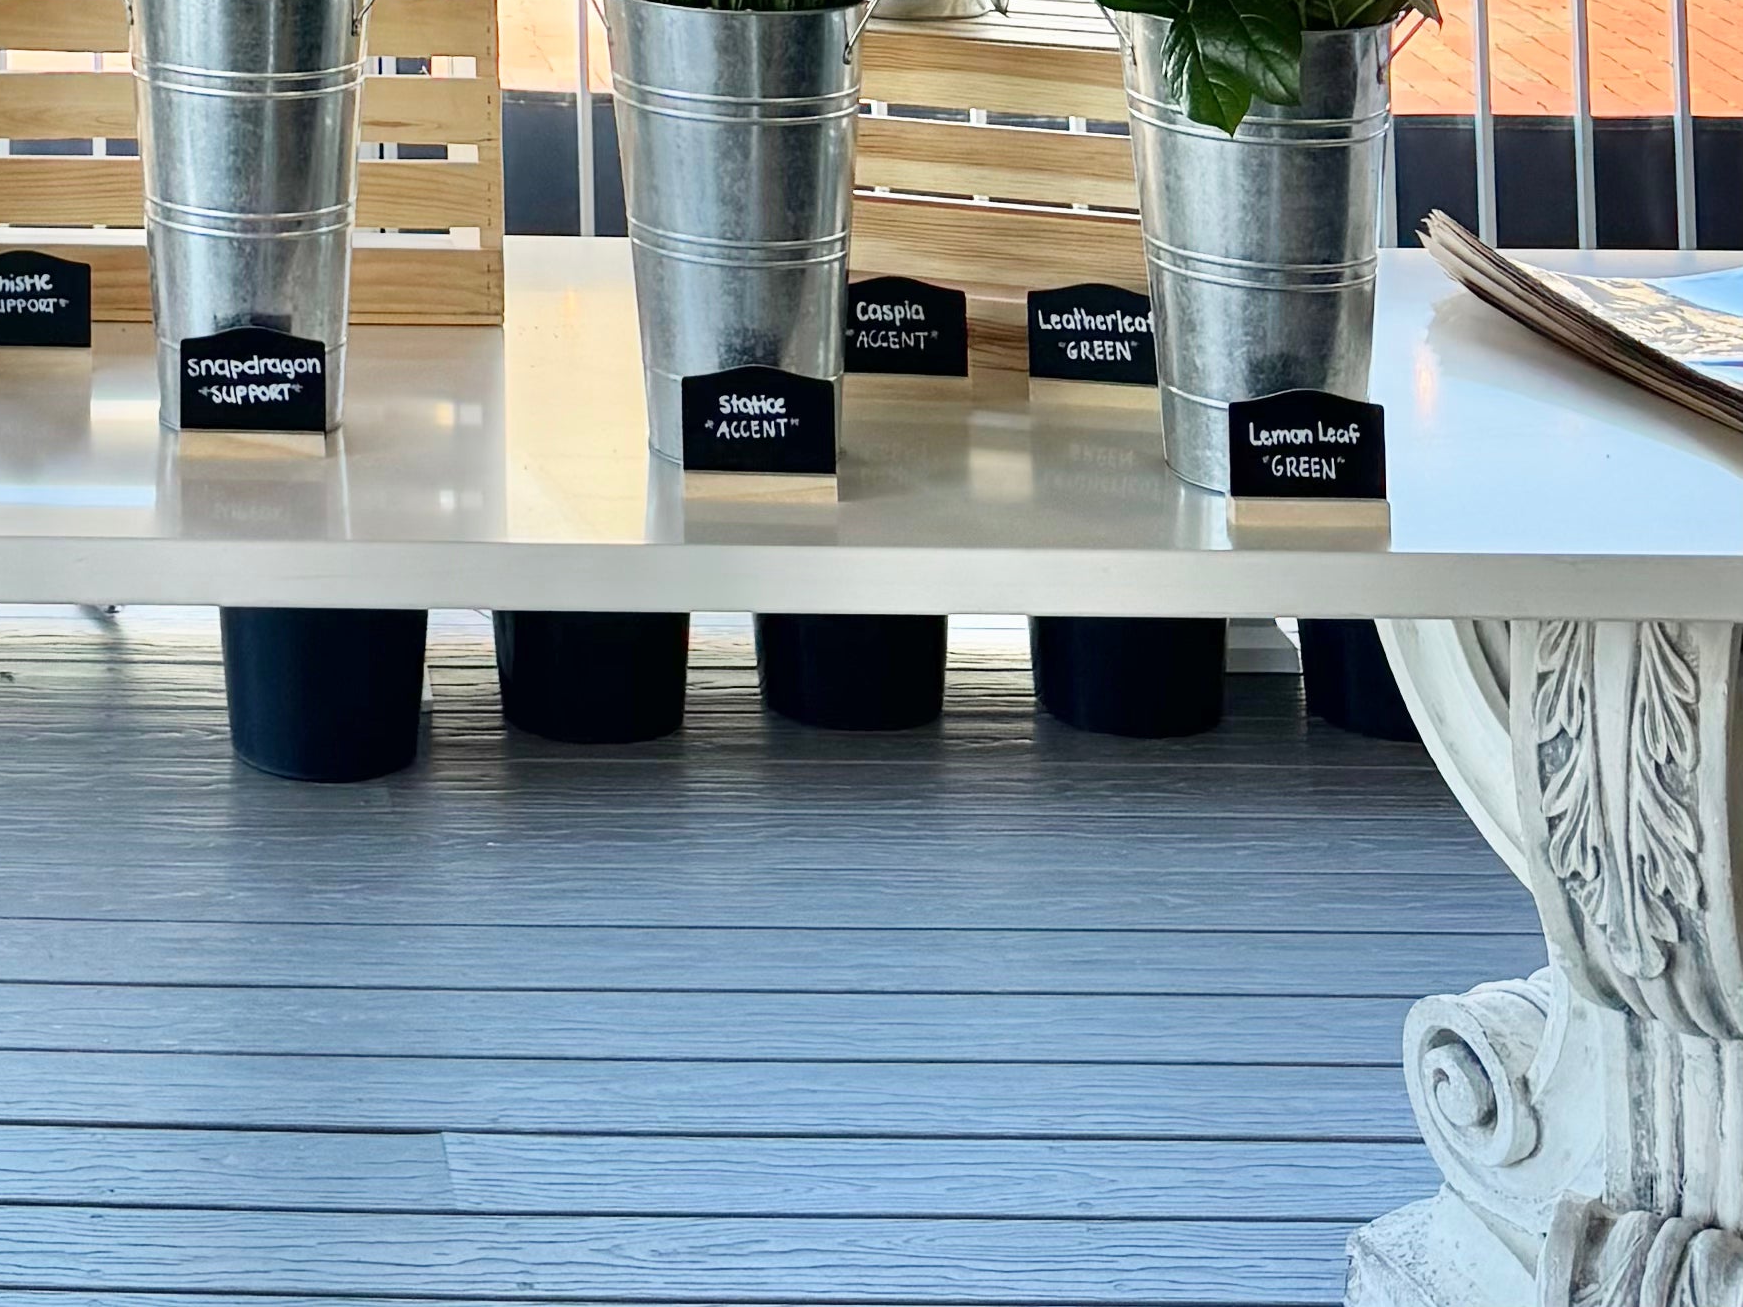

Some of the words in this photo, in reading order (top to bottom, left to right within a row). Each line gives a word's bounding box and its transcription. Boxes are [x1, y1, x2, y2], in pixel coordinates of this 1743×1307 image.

[856, 300, 925, 326] Caspia
[187, 355, 322, 380] Snapdragon
[718, 393, 787, 415] Statice
[1249, 421, 1313, 446] Lemon
[1317, 420, 1361, 444] Leaf
